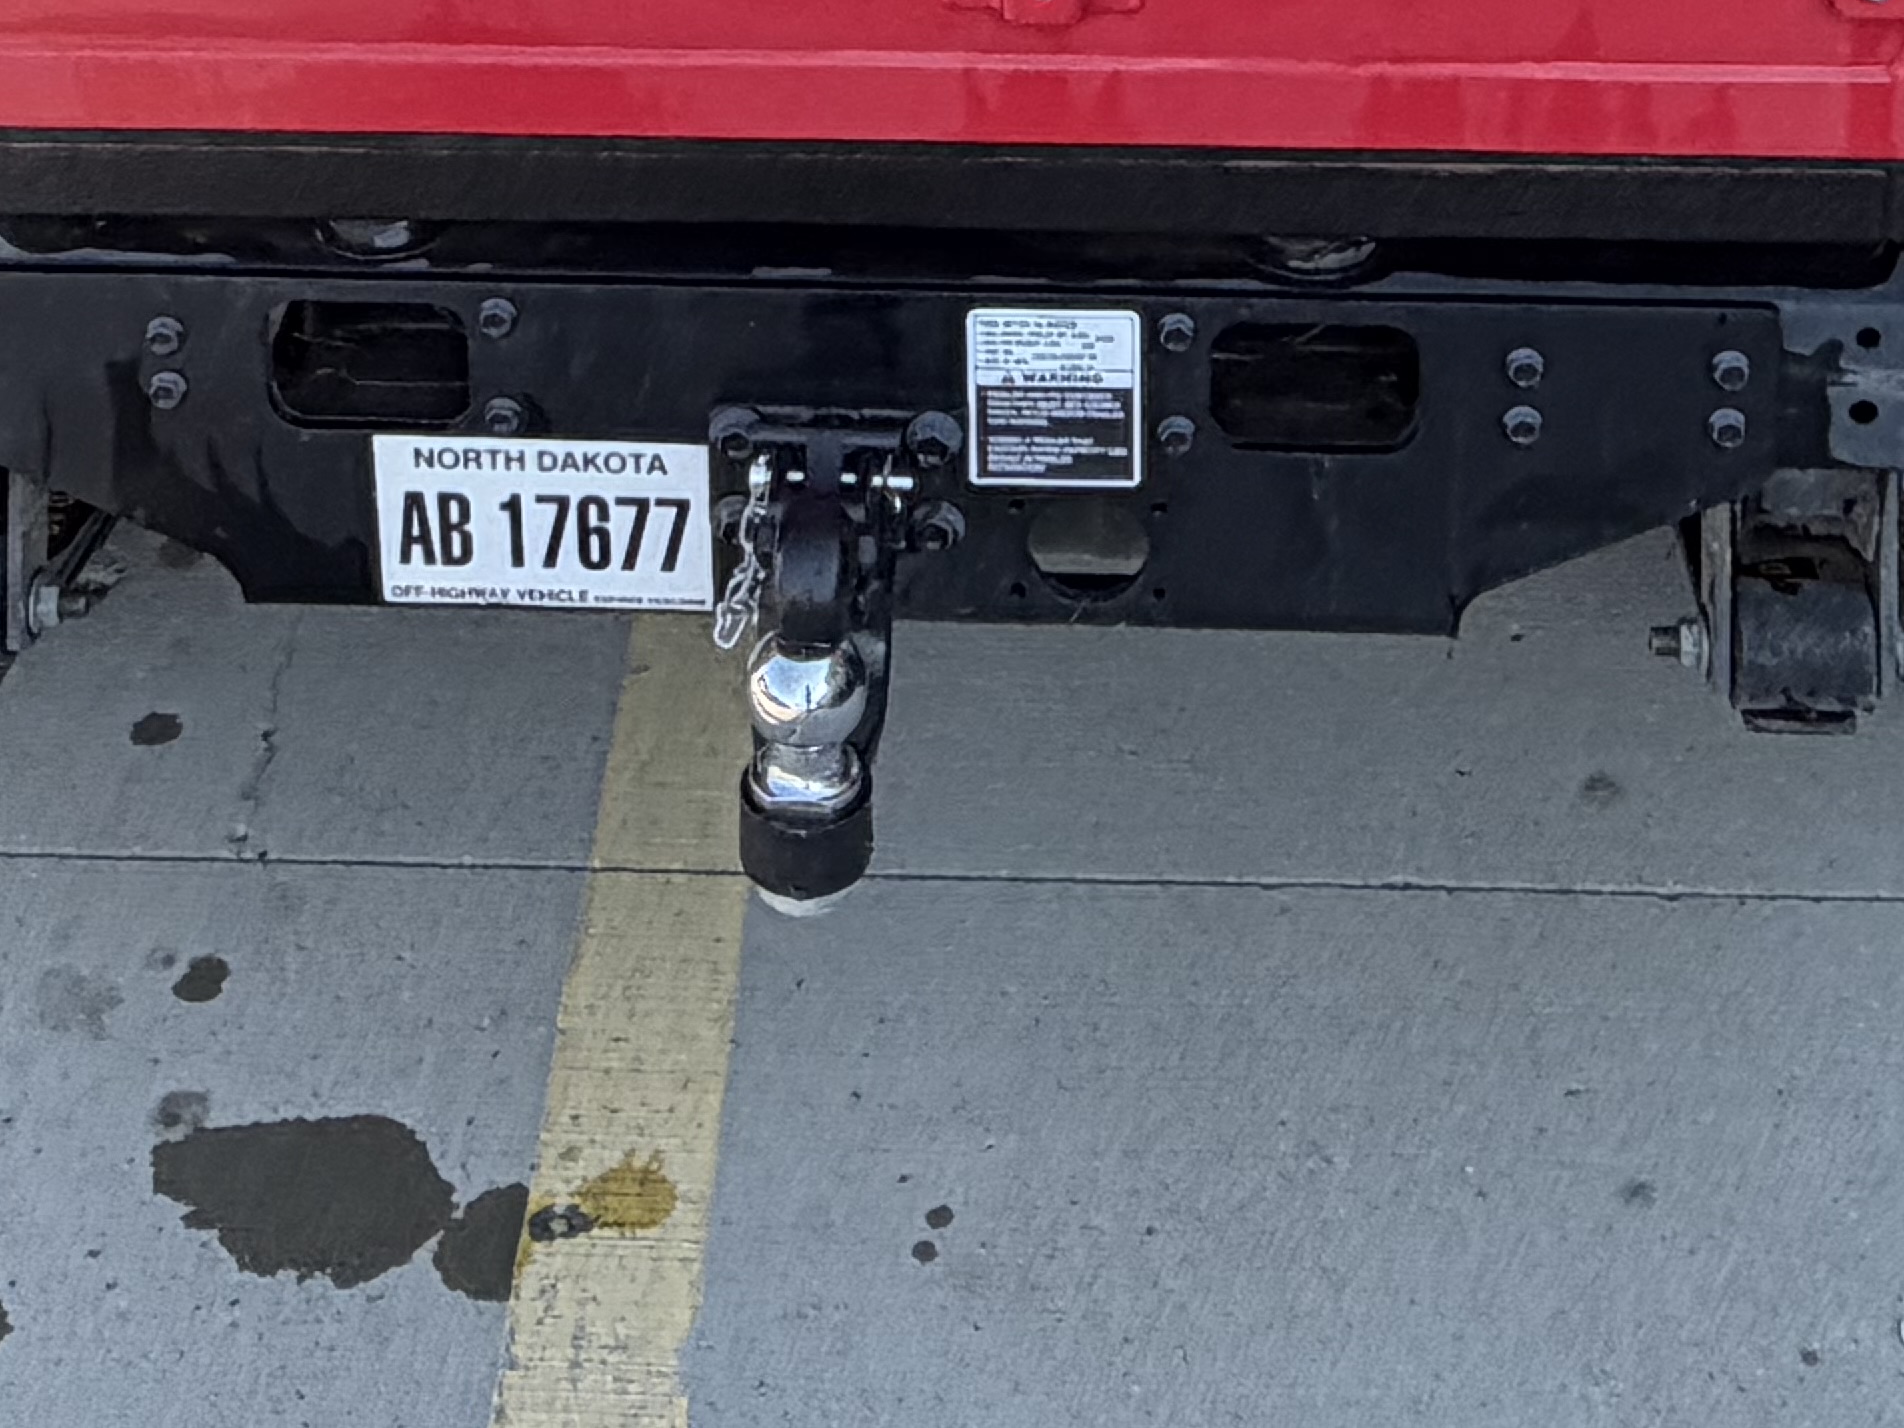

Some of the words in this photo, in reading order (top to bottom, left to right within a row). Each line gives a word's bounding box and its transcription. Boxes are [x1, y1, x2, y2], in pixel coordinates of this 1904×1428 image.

[413, 446, 526, 472] NORTH
[536, 449, 669, 476] DAKOTA
[398, 490, 474, 567] AB
[498, 492, 692, 573] 17677
[516, 588, 590, 605] VEHICLE
